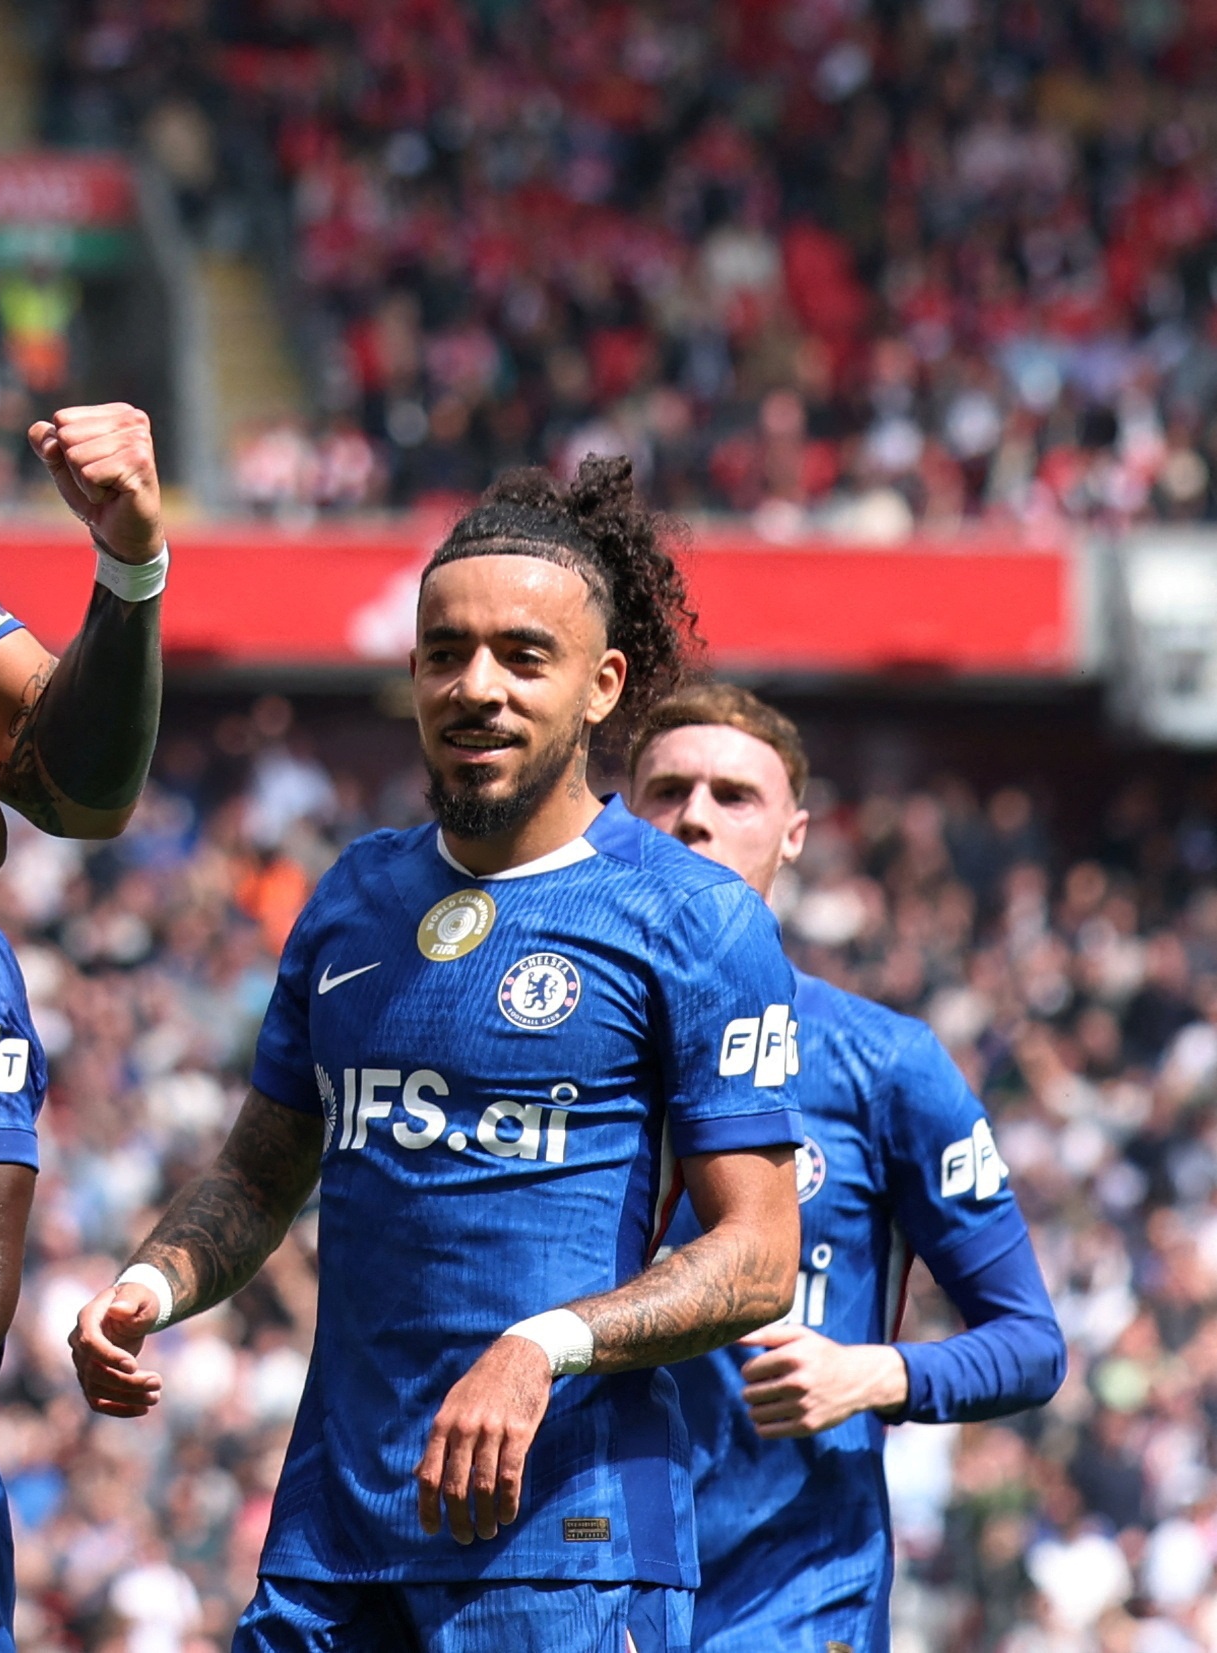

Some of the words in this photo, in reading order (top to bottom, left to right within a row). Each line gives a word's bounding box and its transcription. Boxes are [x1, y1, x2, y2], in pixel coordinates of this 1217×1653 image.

[425, 900, 456, 931] WORLD
[430, 943, 460, 955] FIFA
[519, 956, 570, 975] CHELSEA
[338, 1067, 579, 1164] IFS.ai
